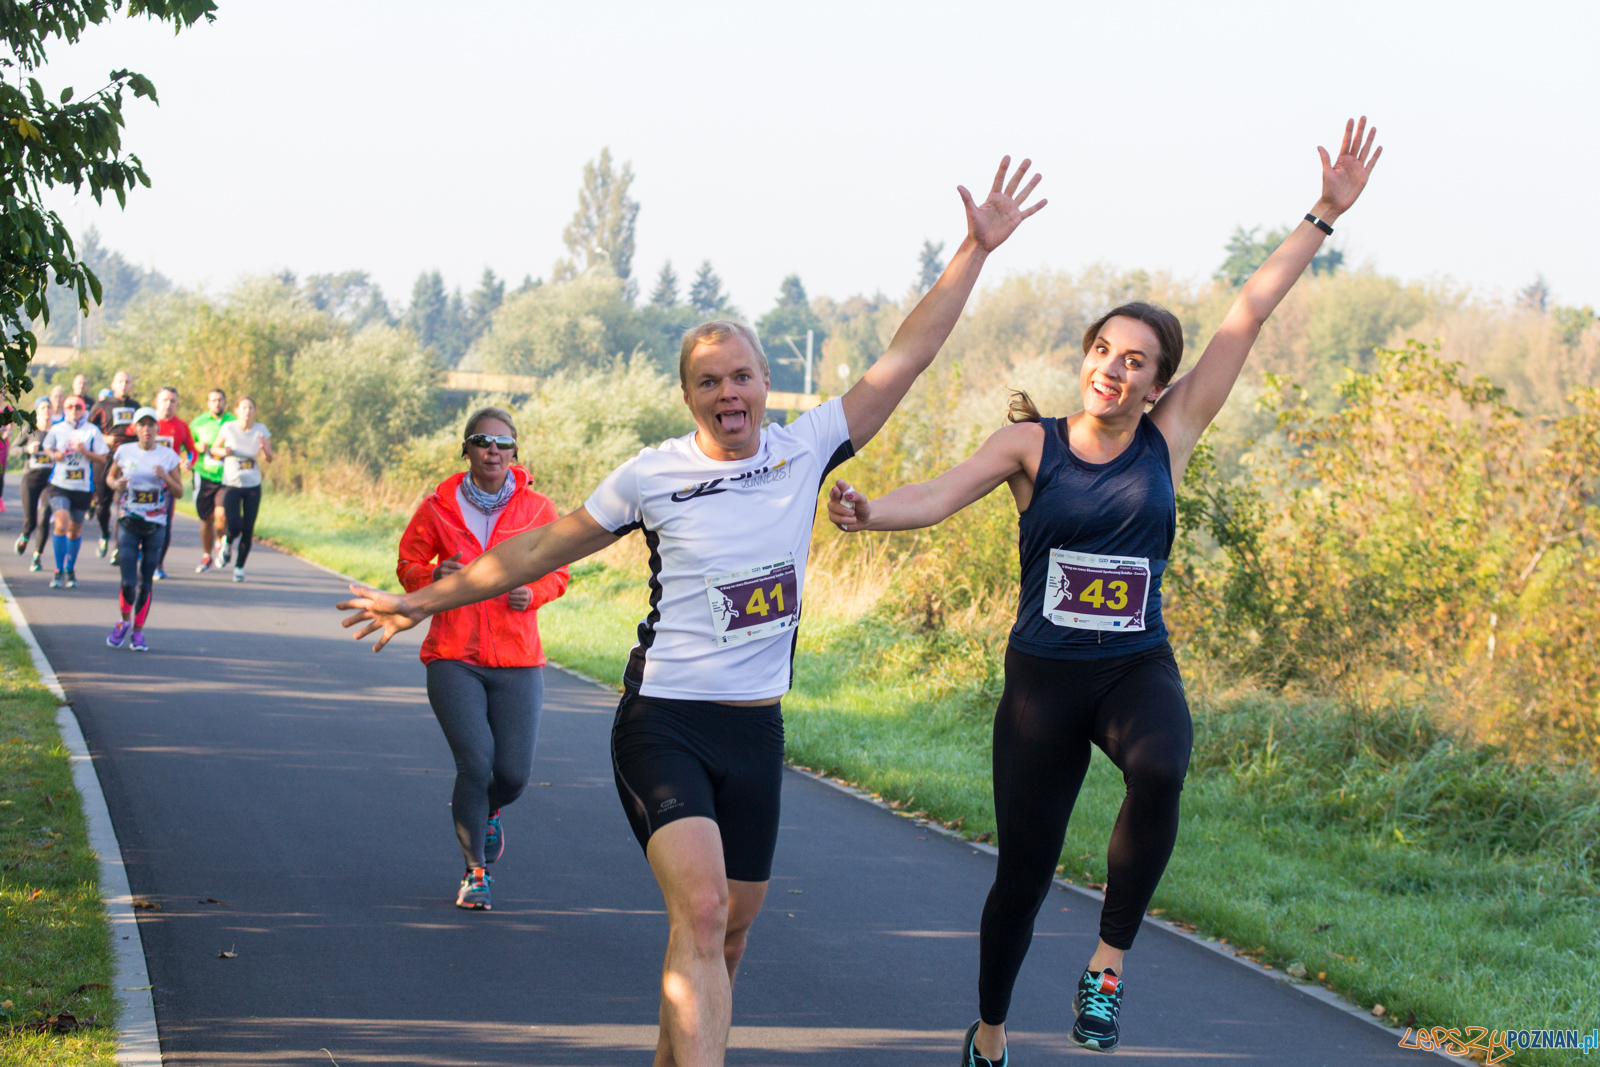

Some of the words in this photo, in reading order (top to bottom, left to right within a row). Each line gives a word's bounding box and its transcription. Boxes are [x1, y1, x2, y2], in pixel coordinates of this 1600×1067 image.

[70, 471, 82, 479] 34
[138, 493, 153, 502] 21
[746, 583, 785, 617] 41
[1079, 578, 1128, 610] 43
